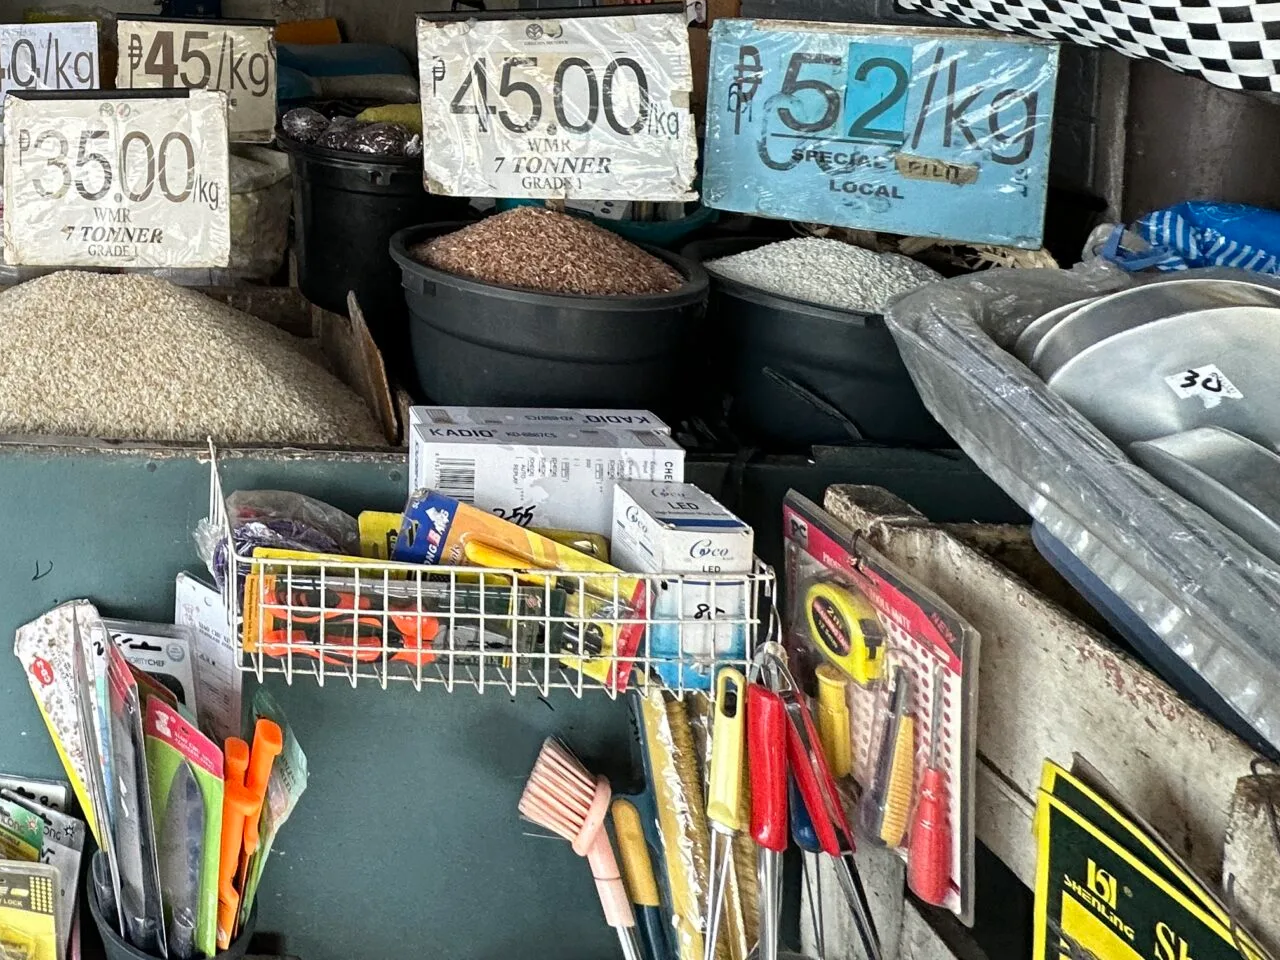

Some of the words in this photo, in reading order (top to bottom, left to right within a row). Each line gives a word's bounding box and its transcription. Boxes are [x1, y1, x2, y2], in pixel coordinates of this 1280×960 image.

[526, 138, 572, 152] WMR
[494, 157, 506, 173] 7
[511, 157, 612, 174] TONNER
[792, 148, 888, 170] SPECIAL
[521, 176, 574, 190] GRADE
[829, 179, 905, 200] LOCAL
[94, 208, 132, 223] WMR
[81, 226, 163, 244] TONNER
[88, 243, 129, 257] GRADE
[1179, 369, 1222, 392] 30
[587, 415, 651, 425] KADIO
[429, 428, 493, 438] KADIO
[667, 502, 700, 510] LED
[702, 565, 721, 573] LED
[4, 899, 23, 907] LOCK
